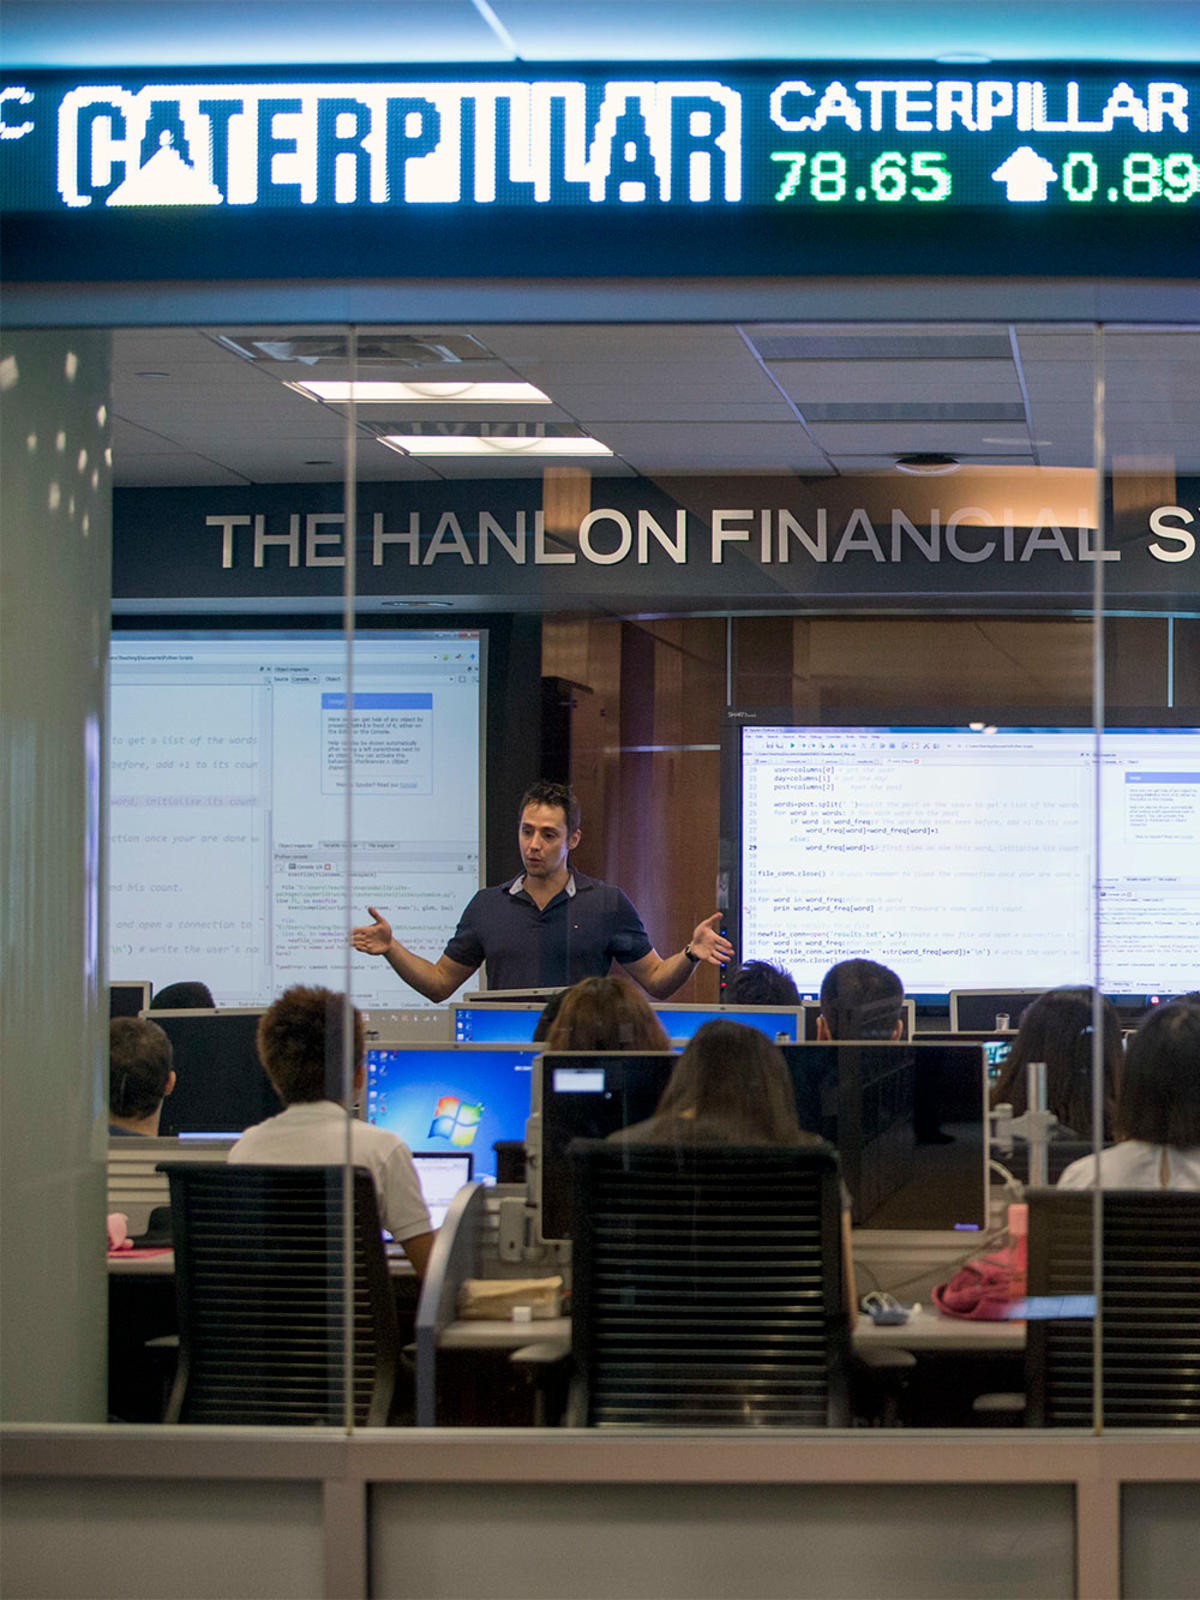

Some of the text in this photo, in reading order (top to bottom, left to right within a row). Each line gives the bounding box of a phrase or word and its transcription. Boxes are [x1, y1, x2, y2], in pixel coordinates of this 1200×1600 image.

[769, 80, 1189, 132] CATERPILLAR
[57, 82, 743, 206] CATERPILLAR
[770, 151, 952, 203] 78.65
[205, 513, 346, 568] THE
[372, 508, 687, 566] HANLON
[710, 506, 1121, 563] FINANCIAL
